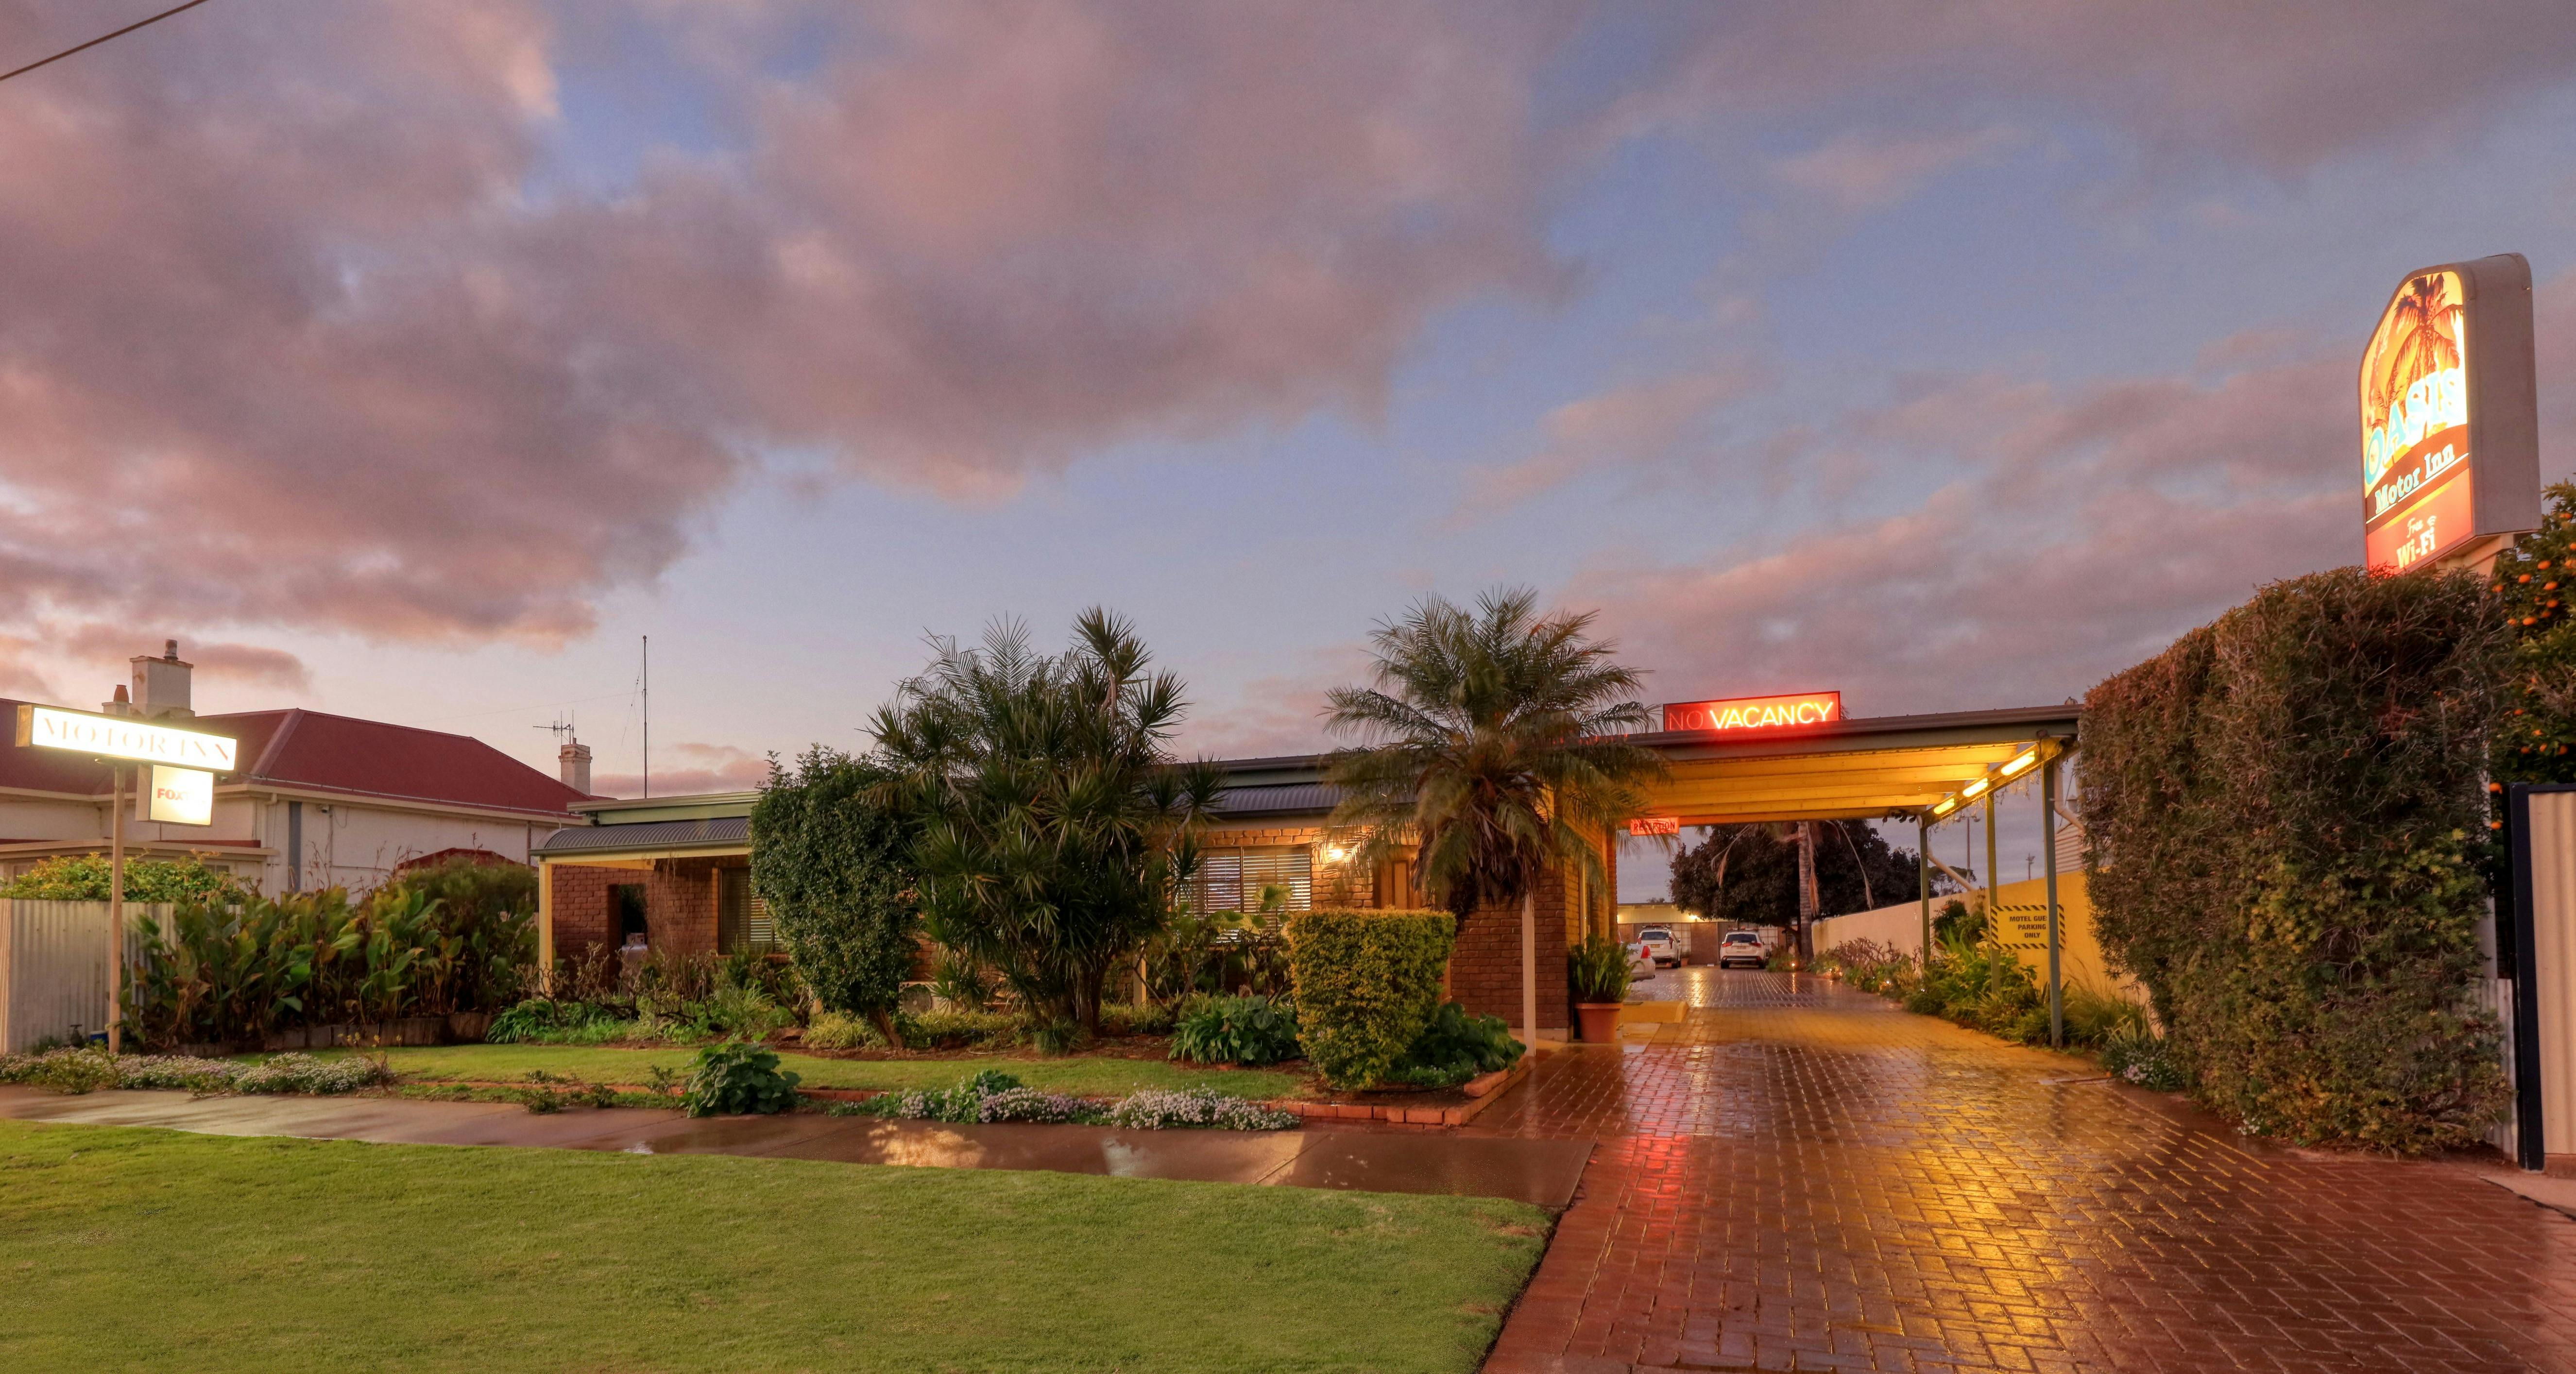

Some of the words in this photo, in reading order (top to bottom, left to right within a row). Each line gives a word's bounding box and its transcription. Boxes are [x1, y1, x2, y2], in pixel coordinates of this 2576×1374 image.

[2365, 368, 2463, 485] OASIS
[2375, 467, 2421, 515] Motor
[2424, 443, 2455, 479] Inn
[2396, 526, 2436, 569] Wi-Fi
[2406, 517, 2424, 538] Free
[1669, 711, 1704, 730] NO
[1709, 702, 1833, 729] VACANCY
[43, 716, 166, 755] MOTOR
[179, 737, 229, 762] INN
